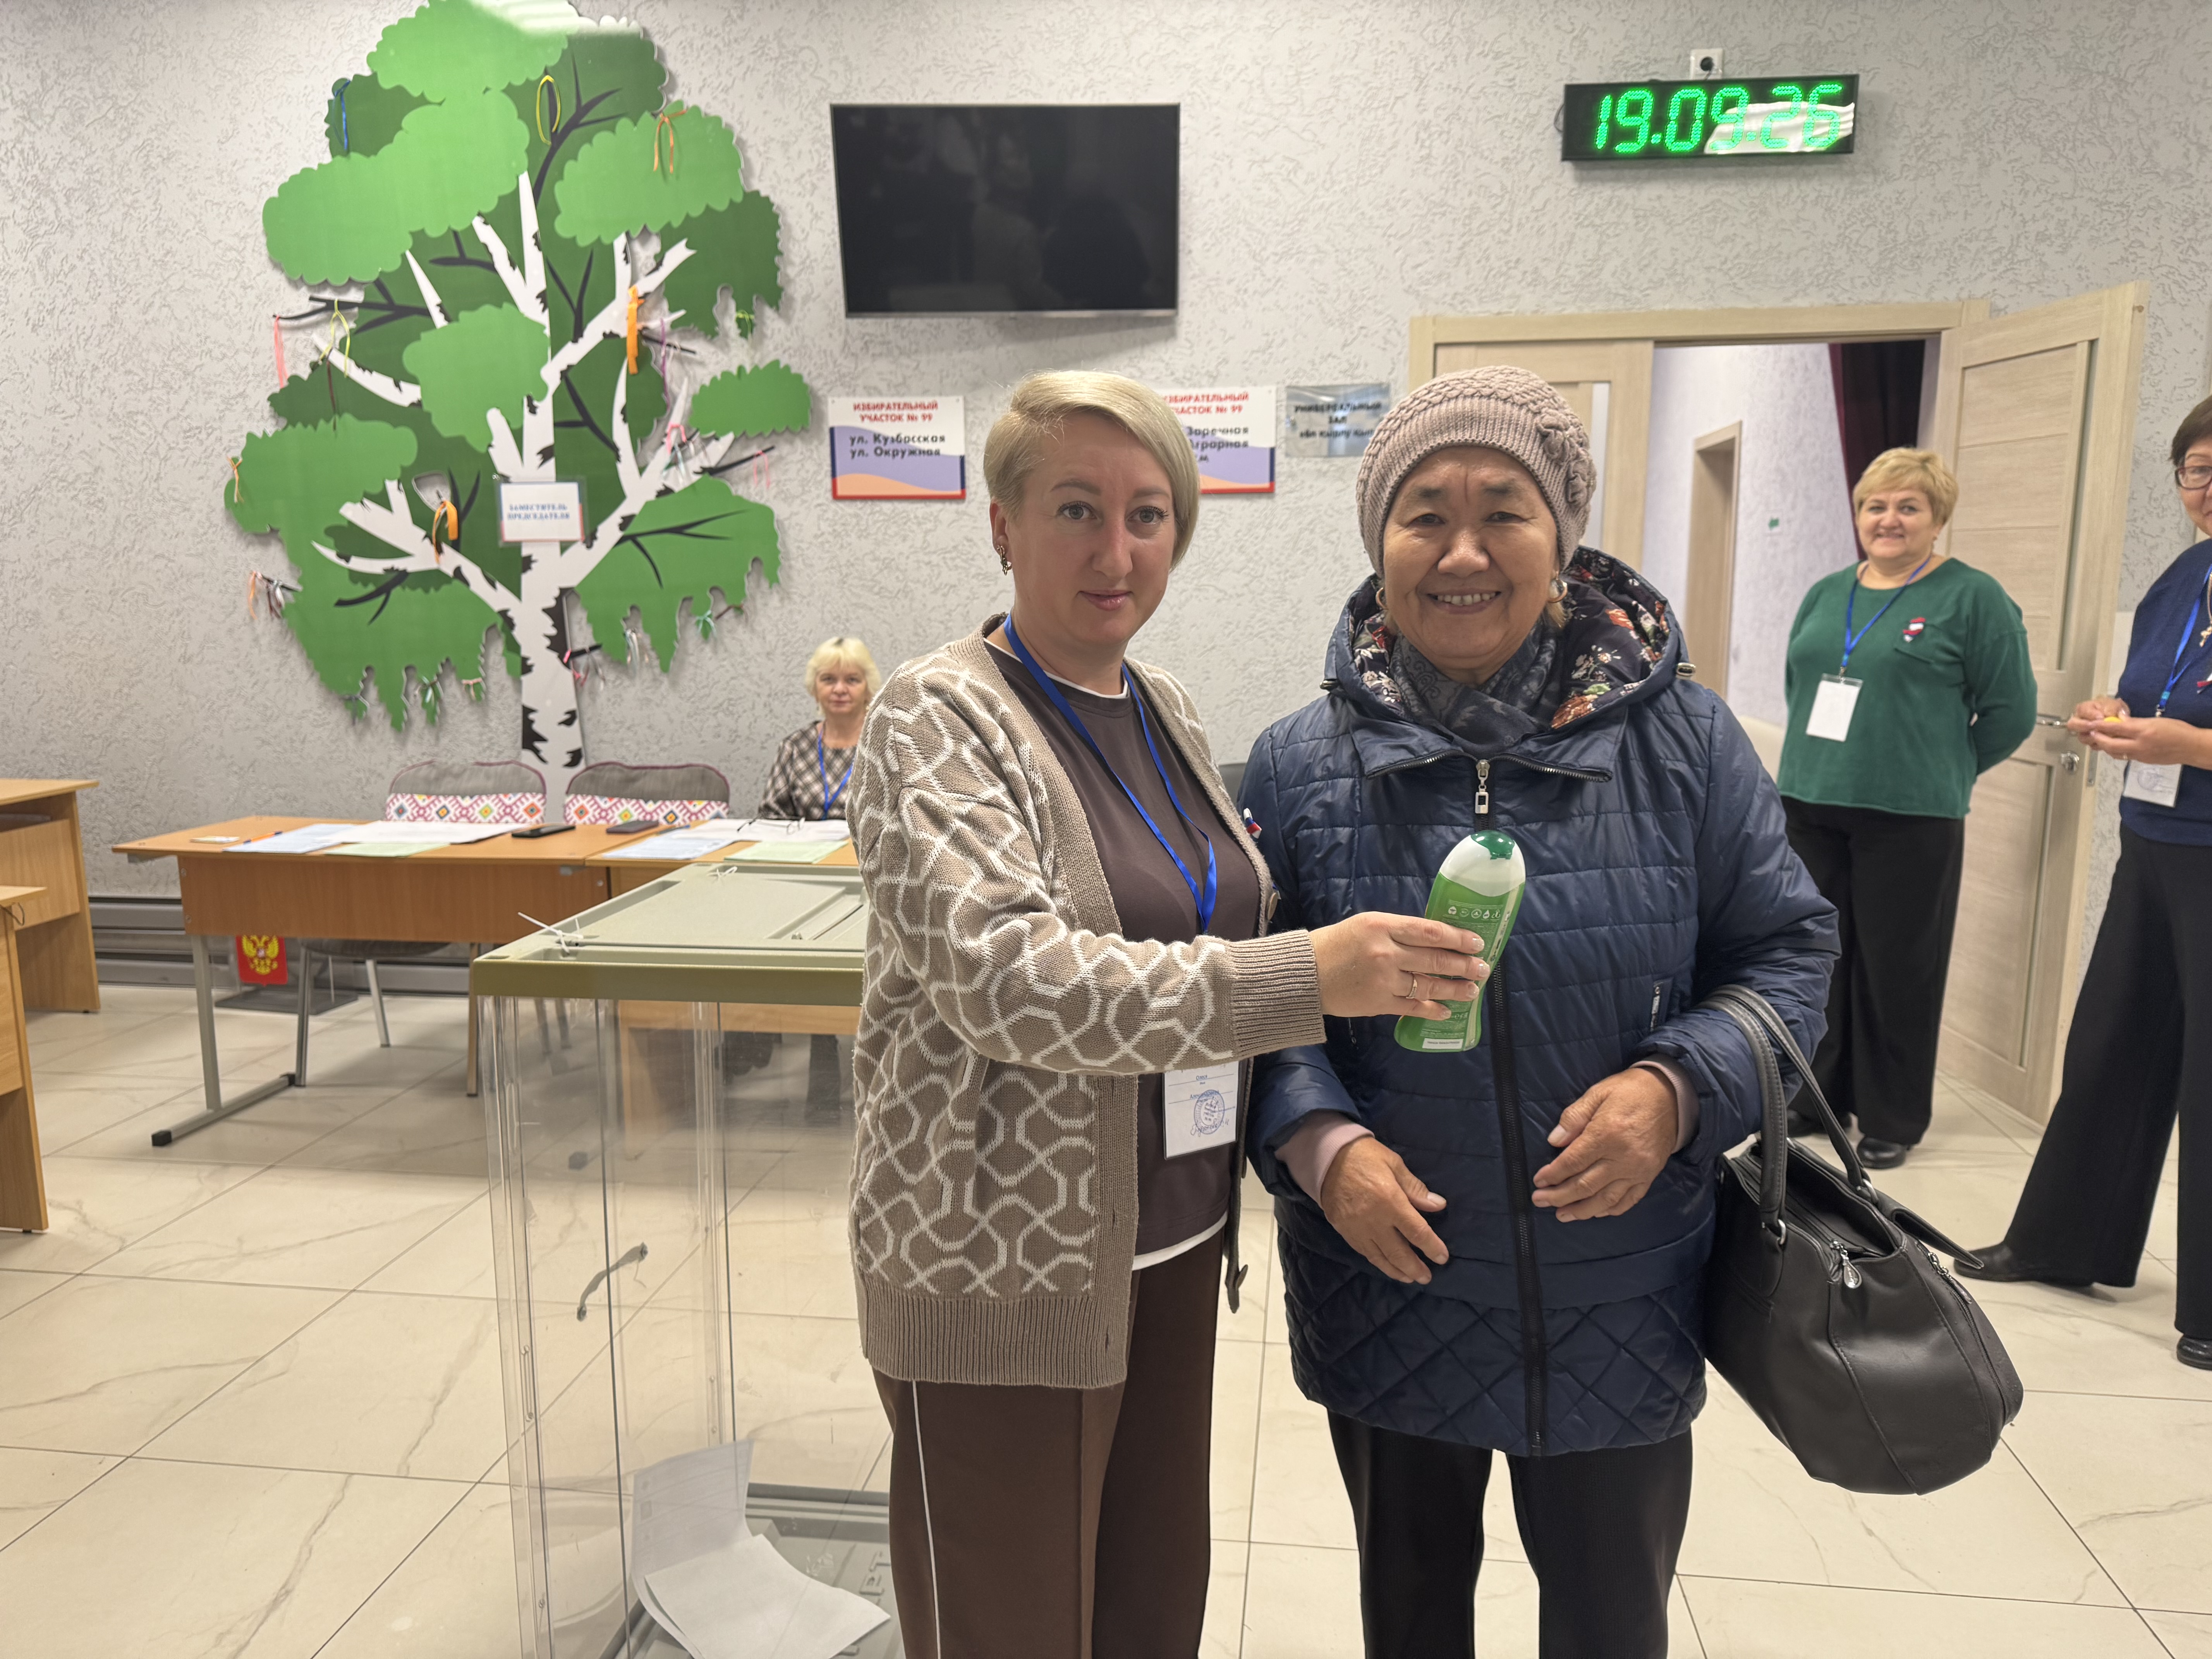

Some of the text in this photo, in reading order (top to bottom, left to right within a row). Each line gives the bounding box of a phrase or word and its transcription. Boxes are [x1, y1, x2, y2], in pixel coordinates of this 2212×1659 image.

[1595, 83, 1843, 153] 19.09.26
[853, 400, 938, 411] ИЗБИРАТЕЛЬНЫЙ
[1231, 405, 1243, 414] 99
[859, 413, 933, 422] УЧАСТОК № 99
[849, 433, 945, 446] ул. Кузбасская
[850, 446, 941, 459] ул. Окружная
